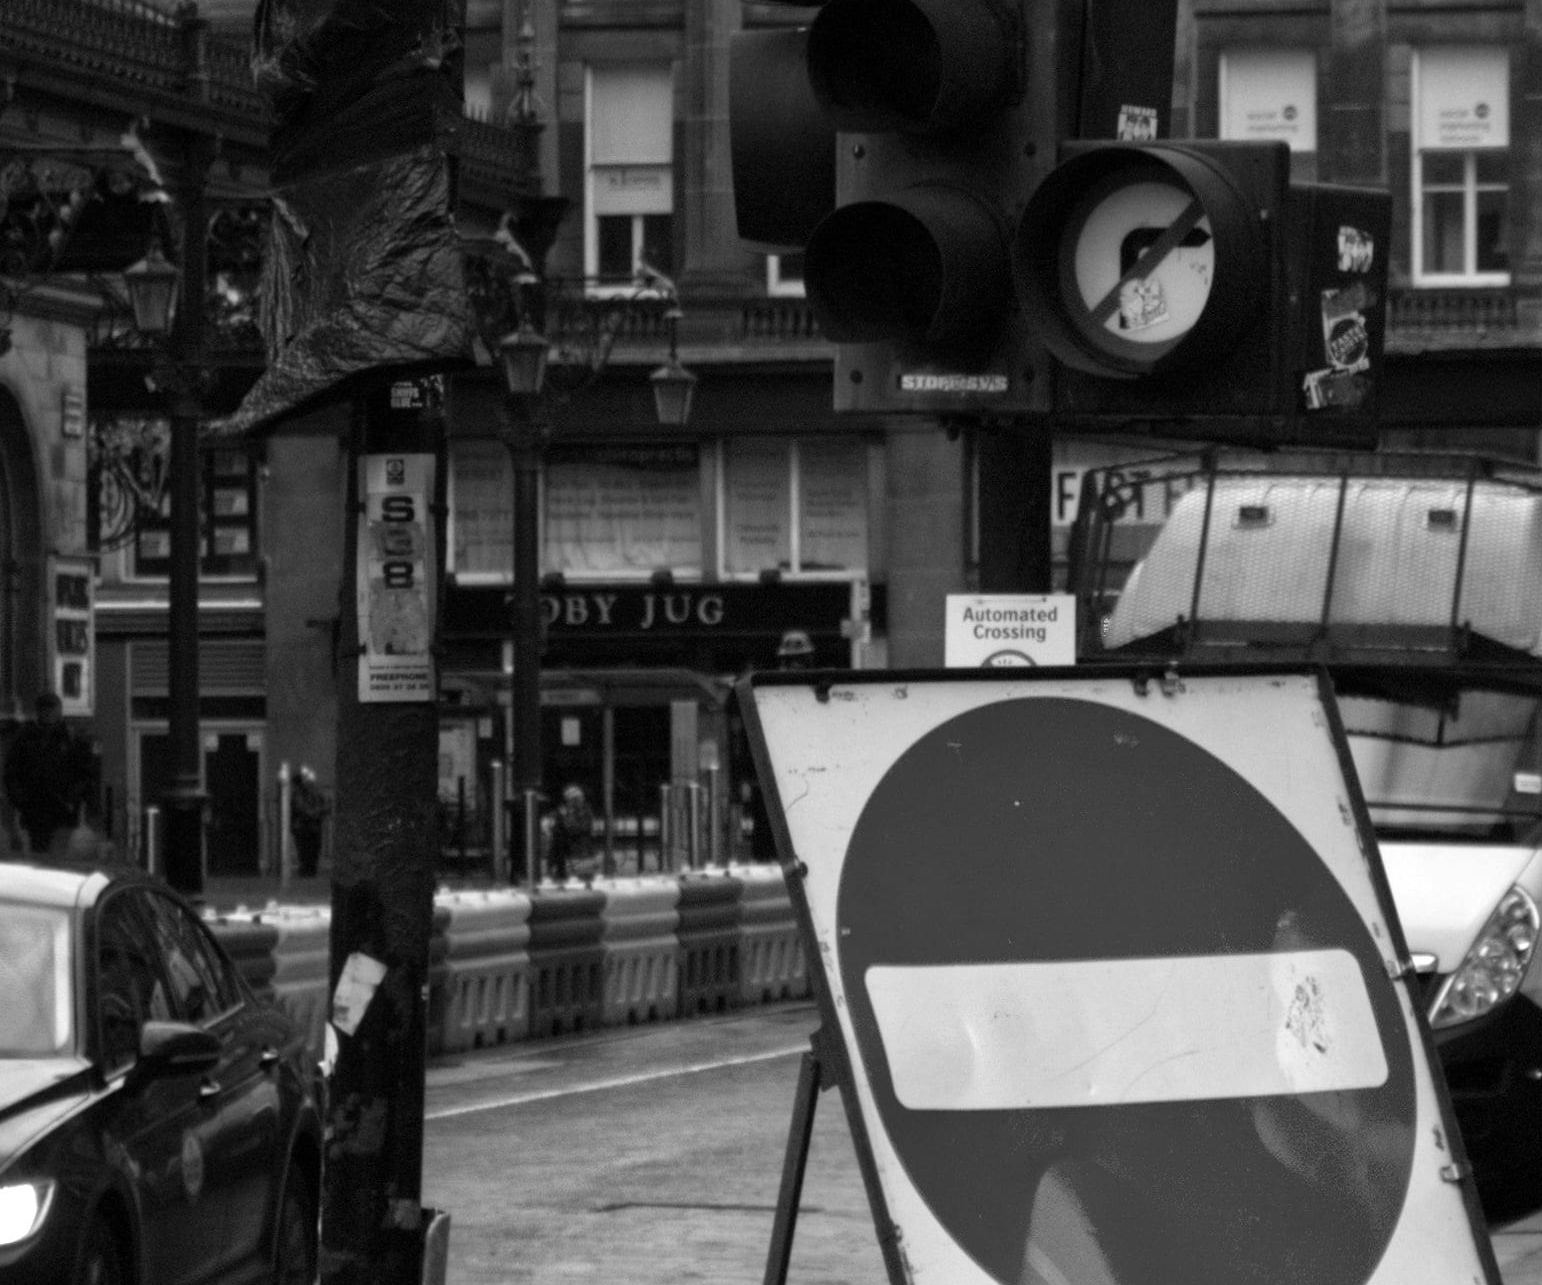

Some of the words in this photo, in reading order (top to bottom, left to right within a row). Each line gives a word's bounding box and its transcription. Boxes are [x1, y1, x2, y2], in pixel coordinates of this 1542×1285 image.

[504, 595, 617, 625] OBY
[640, 595, 725, 630] JUG
[963, 606, 1058, 622] Automated
[973, 624, 1047, 643] Crossing
